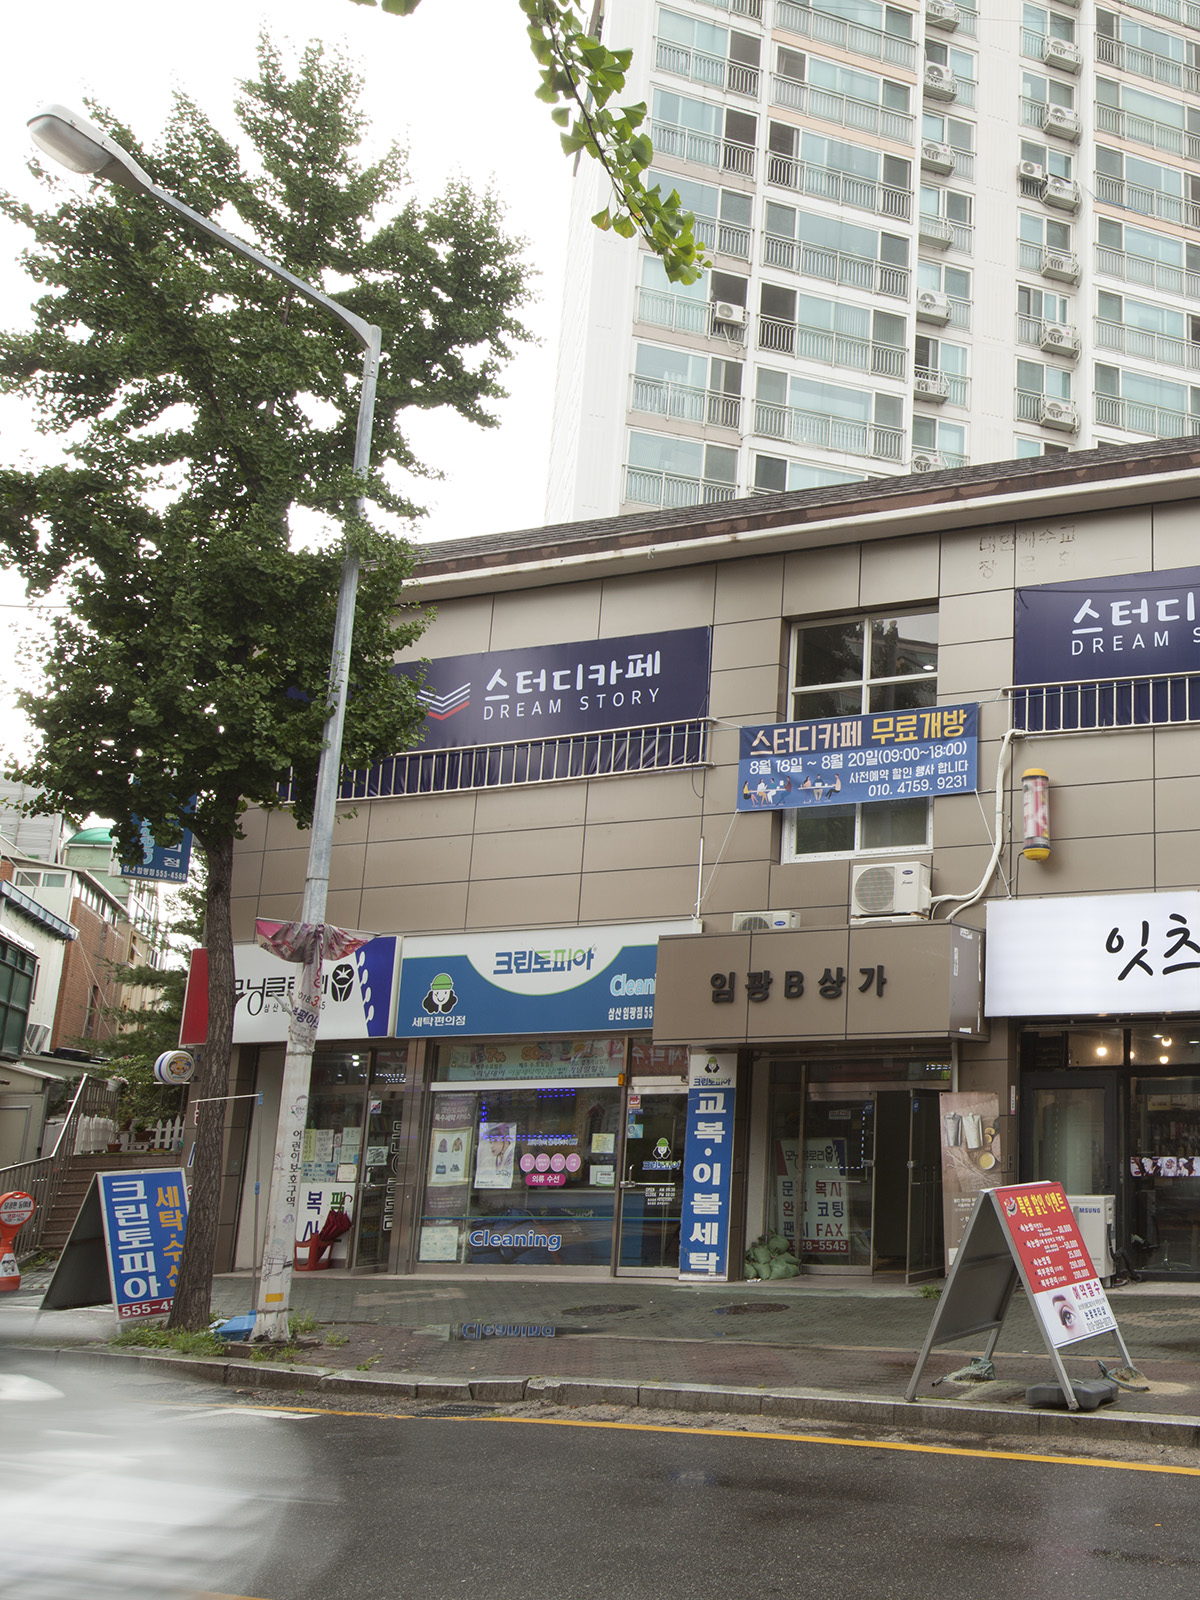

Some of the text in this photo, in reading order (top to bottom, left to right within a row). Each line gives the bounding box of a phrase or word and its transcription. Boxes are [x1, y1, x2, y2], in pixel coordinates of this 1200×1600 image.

[1071, 630, 1169, 656] DREAM
[484, 650, 661, 701] 스터디카페
[483, 688, 659, 721] DREAM STORY
[750, 709, 967, 756] 스터디카페 무료개방
[750, 759, 772, 775] 8월
[775, 757, 803, 773] 18일
[821, 753, 843, 770] 8월
[849, 760, 968, 784] 사전예약 할인 행사 합니다
[868, 774, 967, 797] 010. 4759. 9231
[493, 947, 595, 975] 크린토피아
[610, 973, 657, 997] Clean
[411, 1015, 466, 1028] 세탁편의점
[608, 1007, 621, 1021] 삼산
[622, 1006, 643, 1020] 임광점
[693, 1076, 731, 1086] 크린토피아
[286, 1130, 303, 1207] 어린이보호구역
[531, 1175, 560, 1184] 의류 수선
[816, 1181, 842, 1197] 복사
[817, 1201, 844, 1218] 코팅
[1016, 1192, 1067, 1217] 특별 할인 이벤트
[111, 1179, 161, 1299] 크린토피아
[469, 1229, 562, 1252] Cleaning
[816, 1223, 843, 1237] FAX
[1072, 1283, 1101, 1301] 예약필수
[121, 1302, 173, 1317] 555-4
